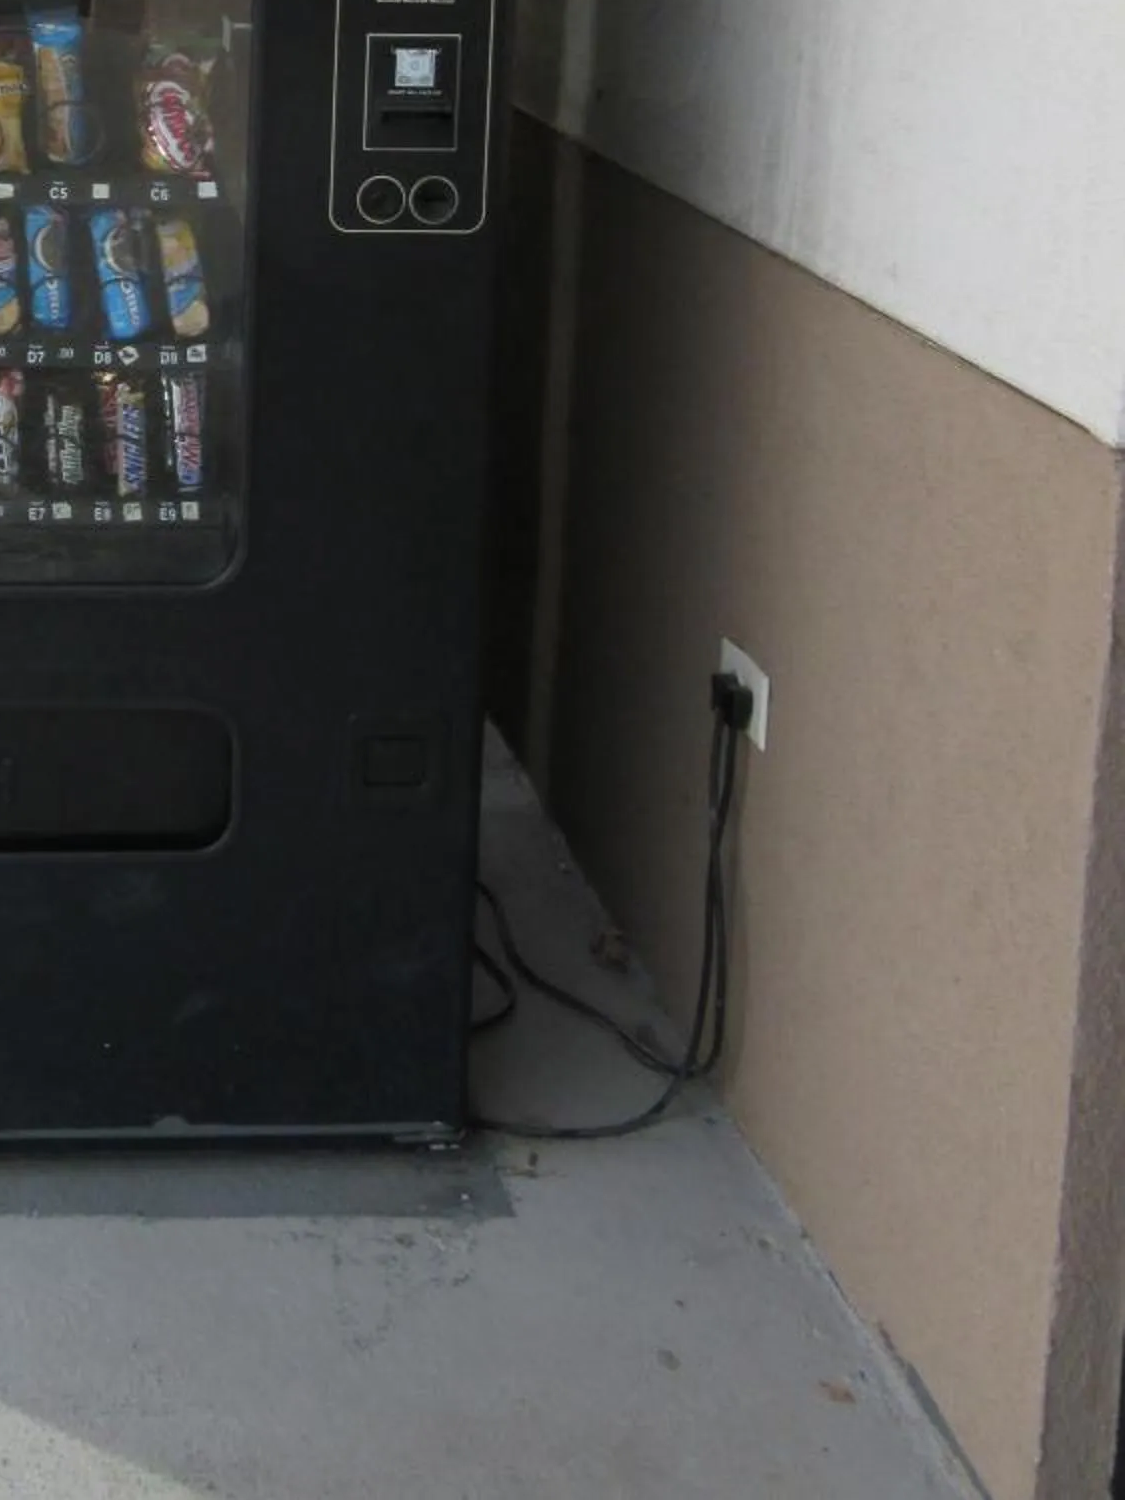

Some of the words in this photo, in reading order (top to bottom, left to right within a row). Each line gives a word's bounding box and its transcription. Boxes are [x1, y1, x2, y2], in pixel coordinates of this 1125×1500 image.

[49, 186, 68, 200] C5
[150, 187, 170, 201] C6
[27, 350, 45, 365] D7
[28, 507, 46, 522] E7
[158, 507, 177, 522] E9
